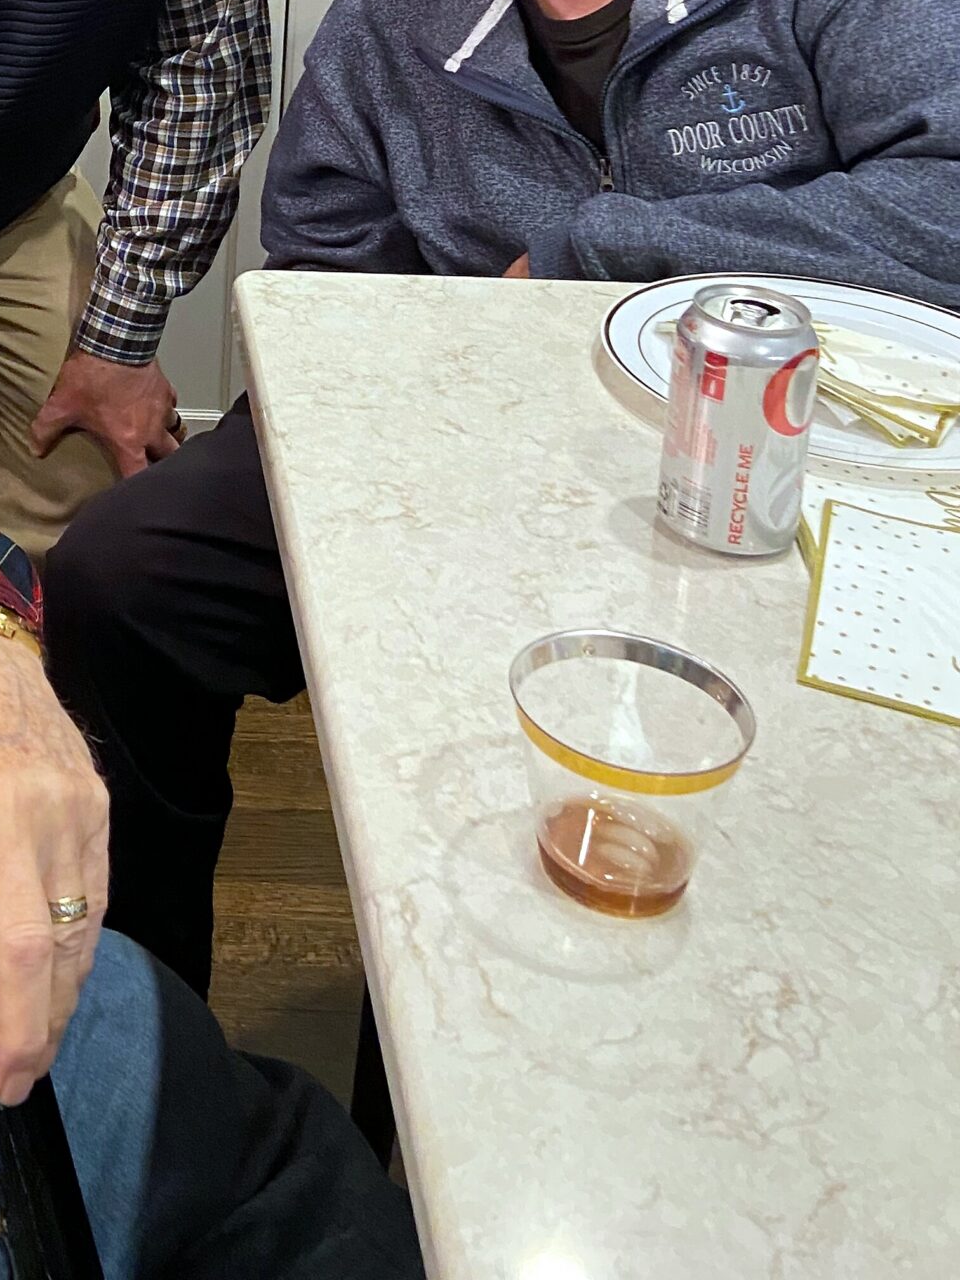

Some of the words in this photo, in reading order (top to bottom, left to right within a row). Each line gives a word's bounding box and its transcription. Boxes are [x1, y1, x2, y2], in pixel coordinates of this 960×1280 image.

[681, 65, 723, 101] SINCE
[667, 121, 726, 157] DOOR
[728, 104, 809, 144] COUNTY
[700, 140, 794, 173] WISCONSIN
[737, 443, 754, 470] ME
[728, 472, 750, 545] RECYCLE
